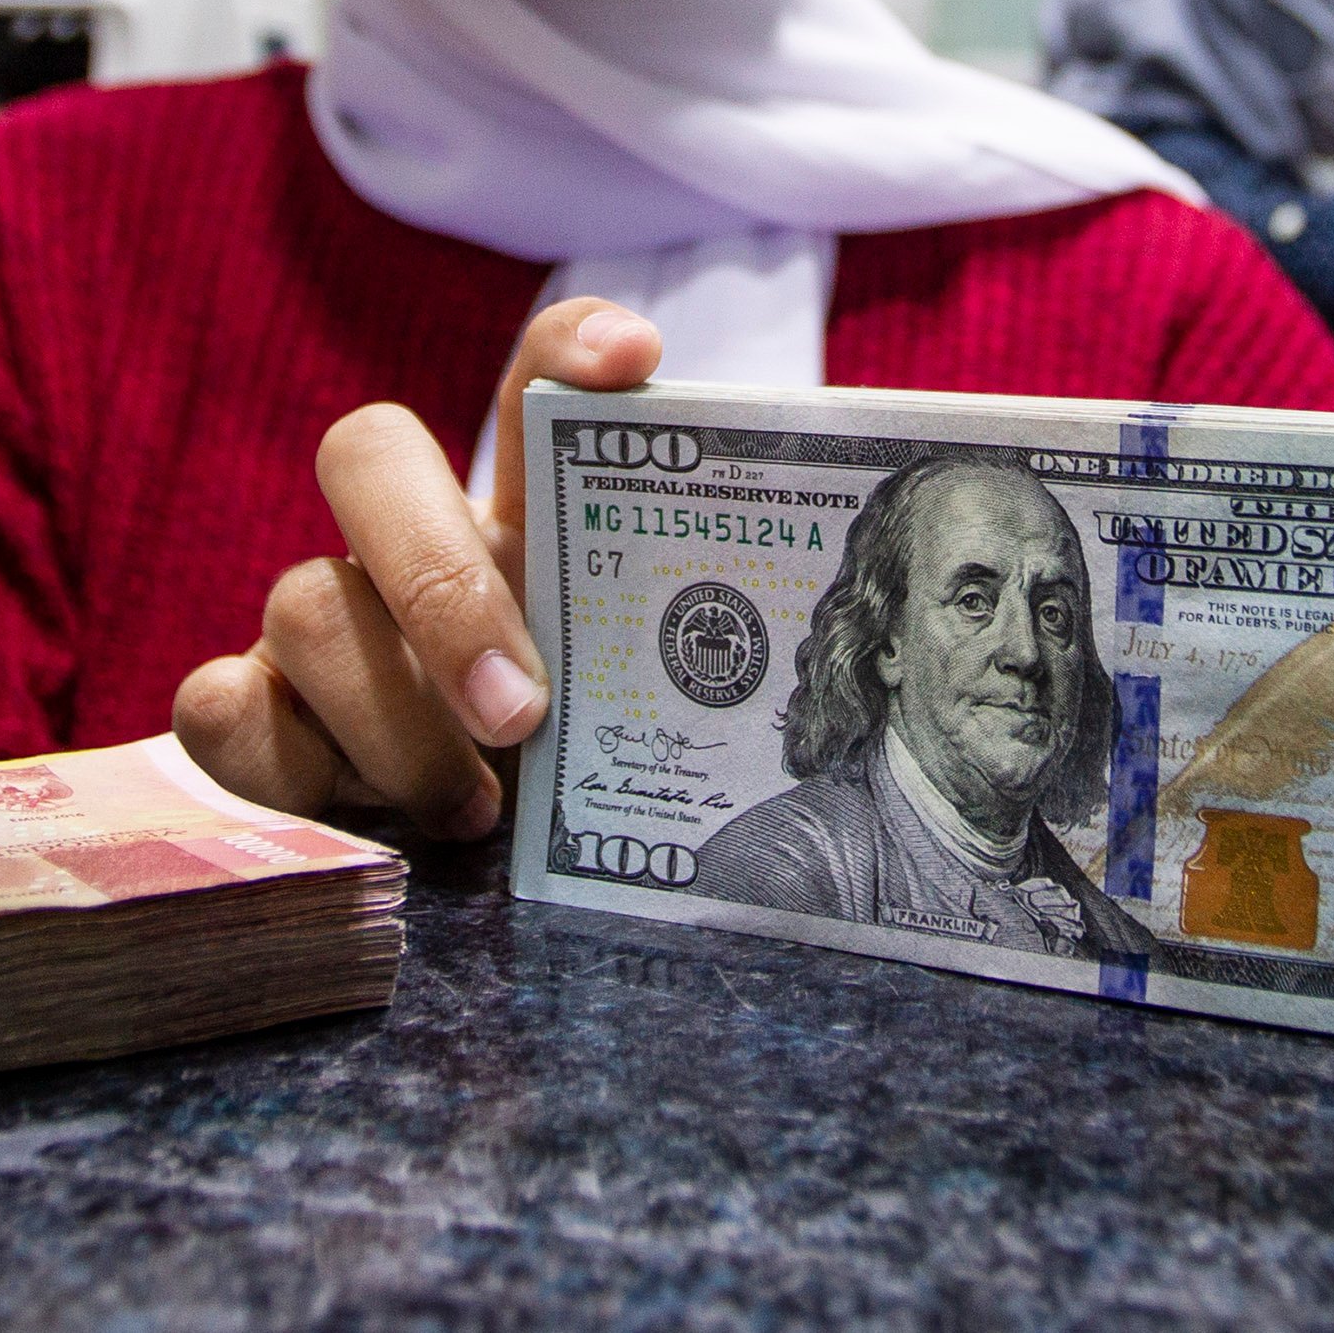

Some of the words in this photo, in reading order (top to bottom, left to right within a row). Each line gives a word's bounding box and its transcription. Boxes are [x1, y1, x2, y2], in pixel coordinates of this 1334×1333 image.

[567, 428, 702, 473] 100
[1028, 453, 1099, 477] ONE
[1107, 459, 1295, 488] HUNDRED
[582, 475, 684, 495] FEDERAL
[685, 482, 792, 505] RESERVE
[794, 491, 860, 510] NOTE
[1092, 510, 1288, 556] UNITED
[1135, 551, 1207, 588] OF
[674, 589, 715, 617] UNITED
[718, 590, 755, 624] STATES
[1178, 611, 1204, 623] FOR
[1208, 614, 1231, 626] ALL
[1285, 620, 1333, 634] PUBLIC
[1208, 601, 1238, 613] THIS
[1241, 604, 1275, 617] NOTE
[1280, 607, 1292, 618] IS
[665, 627, 687, 683] FEDERAL
[688, 681, 739, 701] RESERVE
[740, 637, 764, 687] SYSTEM
[610, 756, 647, 774] Secretary
[648, 762, 659, 775] of
[659, 763, 671, 774] the
[584, 797, 623, 812] Treasurer
[623, 804, 633, 816] of
[634, 805, 646, 816] the
[647, 806, 676, 821] United
[567, 831, 699, 888] 100
[898, 909, 978, 934] FRANKLIN
